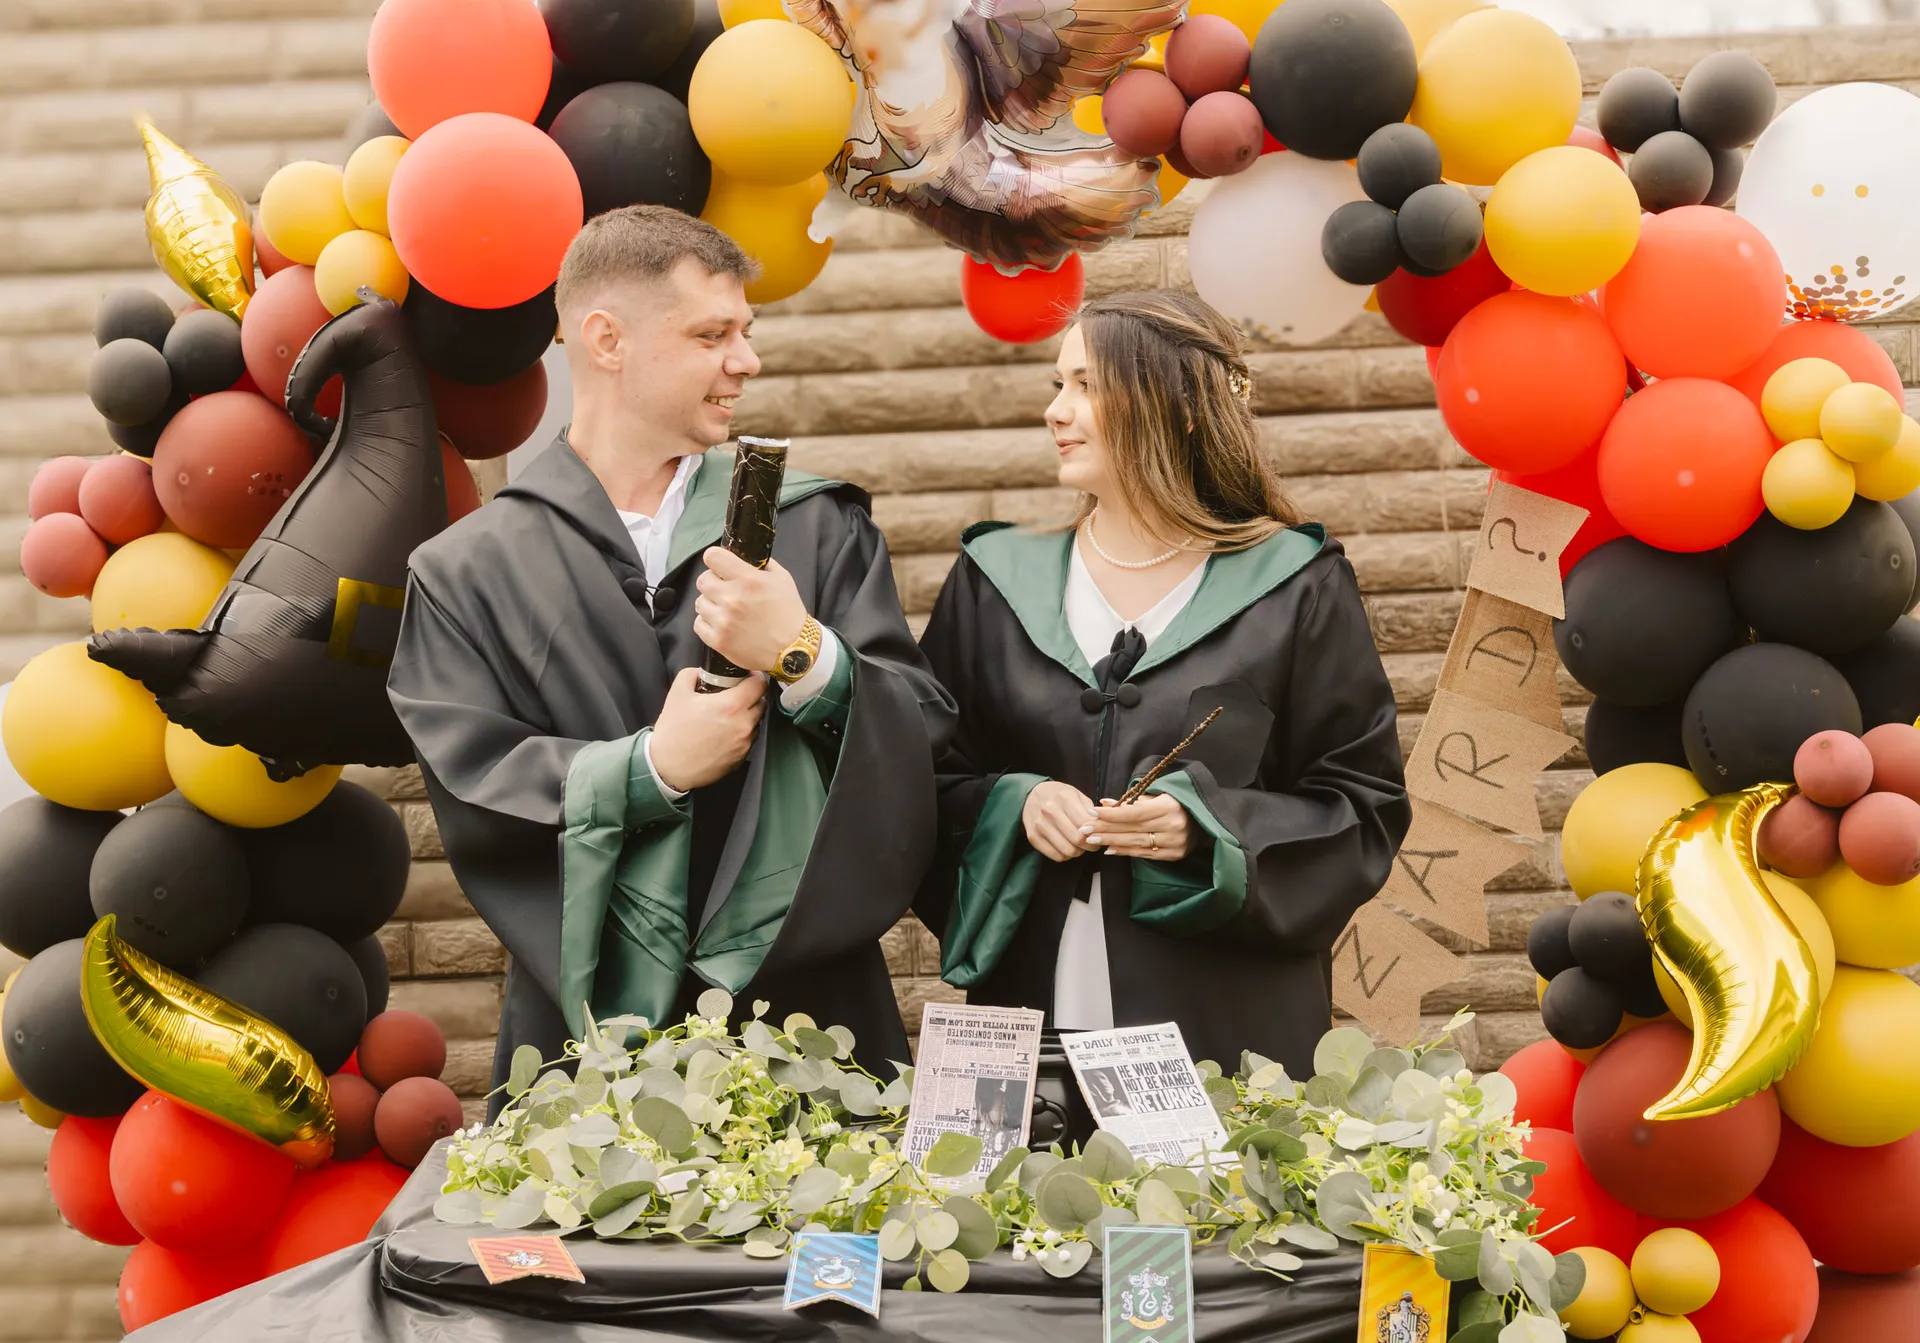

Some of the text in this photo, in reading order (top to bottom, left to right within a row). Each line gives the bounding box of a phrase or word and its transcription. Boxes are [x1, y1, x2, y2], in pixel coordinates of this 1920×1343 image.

[965, 1020, 981, 1028] LIES
[983, 1020, 1008, 1029] POTTER
[1010, 1021, 1036, 1032] HARRY
[946, 1028, 1017, 1041] WANDS CONFISCATED
[945, 1038, 993, 1048] DECOMMISSIONED
[1083, 1032, 1161, 1050] DAILY PROPHET
[1116, 1058, 1189, 1079] HE WHO MUST
[1122, 1072, 1195, 1092] NOT BE NAMED
[1129, 1085, 1206, 1114] RETURNS
[914, 1119, 969, 1129] CONFIRMED
[913, 1126, 936, 1135] SNAPE
